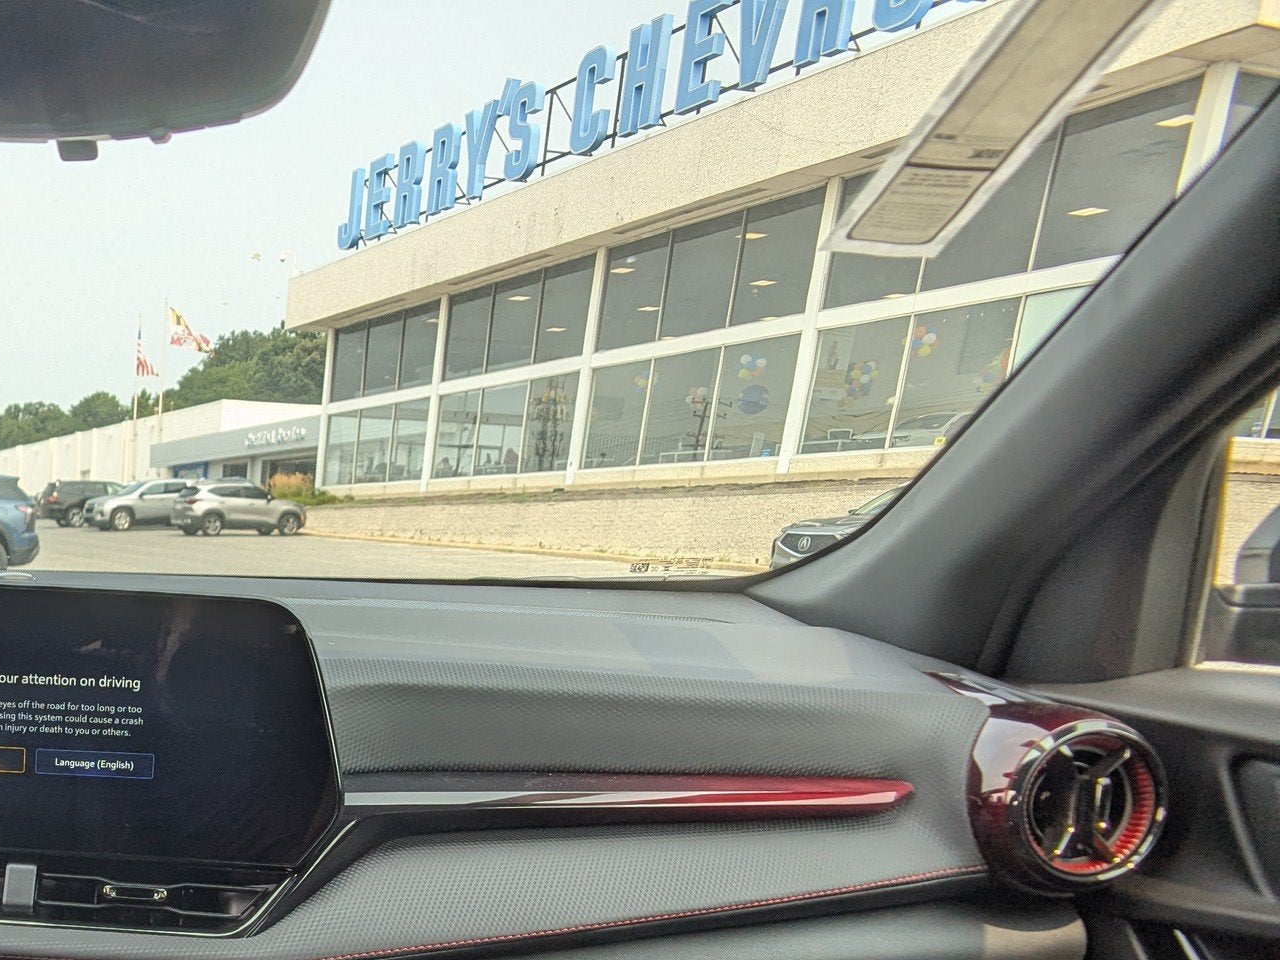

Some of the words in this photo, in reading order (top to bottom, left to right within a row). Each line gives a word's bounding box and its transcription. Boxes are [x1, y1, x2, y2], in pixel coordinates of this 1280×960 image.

[337, 77, 544, 250] JERRY'S
[568, 0, 935, 155] CHEVR
[22, 674, 76, 686] attention
[80, 677, 95, 687] on
[99, 675, 141, 691] driving
[18, 700, 31, 709] off
[32, 701, 45, 710] the
[47, 701, 66, 711] road
[67, 702, 79, 711] for
[81, 703, 95, 712] too
[97, 703, 115, 714] long
[117, 705, 127, 713] or
[128, 705, 142, 714] too
[18, 712, 32, 720] this
[35, 713, 63, 723] system
[65, 714, 87, 723] could
[89, 716, 112, 724] cause
[114, 717, 120, 725] a
[121, 716, 144, 725] crash
[4, 723, 27, 734] injury
[29, 725, 38, 733] or
[40, 725, 63, 734] death
[65, 726, 73, 735] to
[74, 727, 89, 737] you
[91, 727, 101, 735] or
[102, 727, 131, 737] others.
[55, 757, 95, 769] Language
[97, 759, 134, 771] (English)
